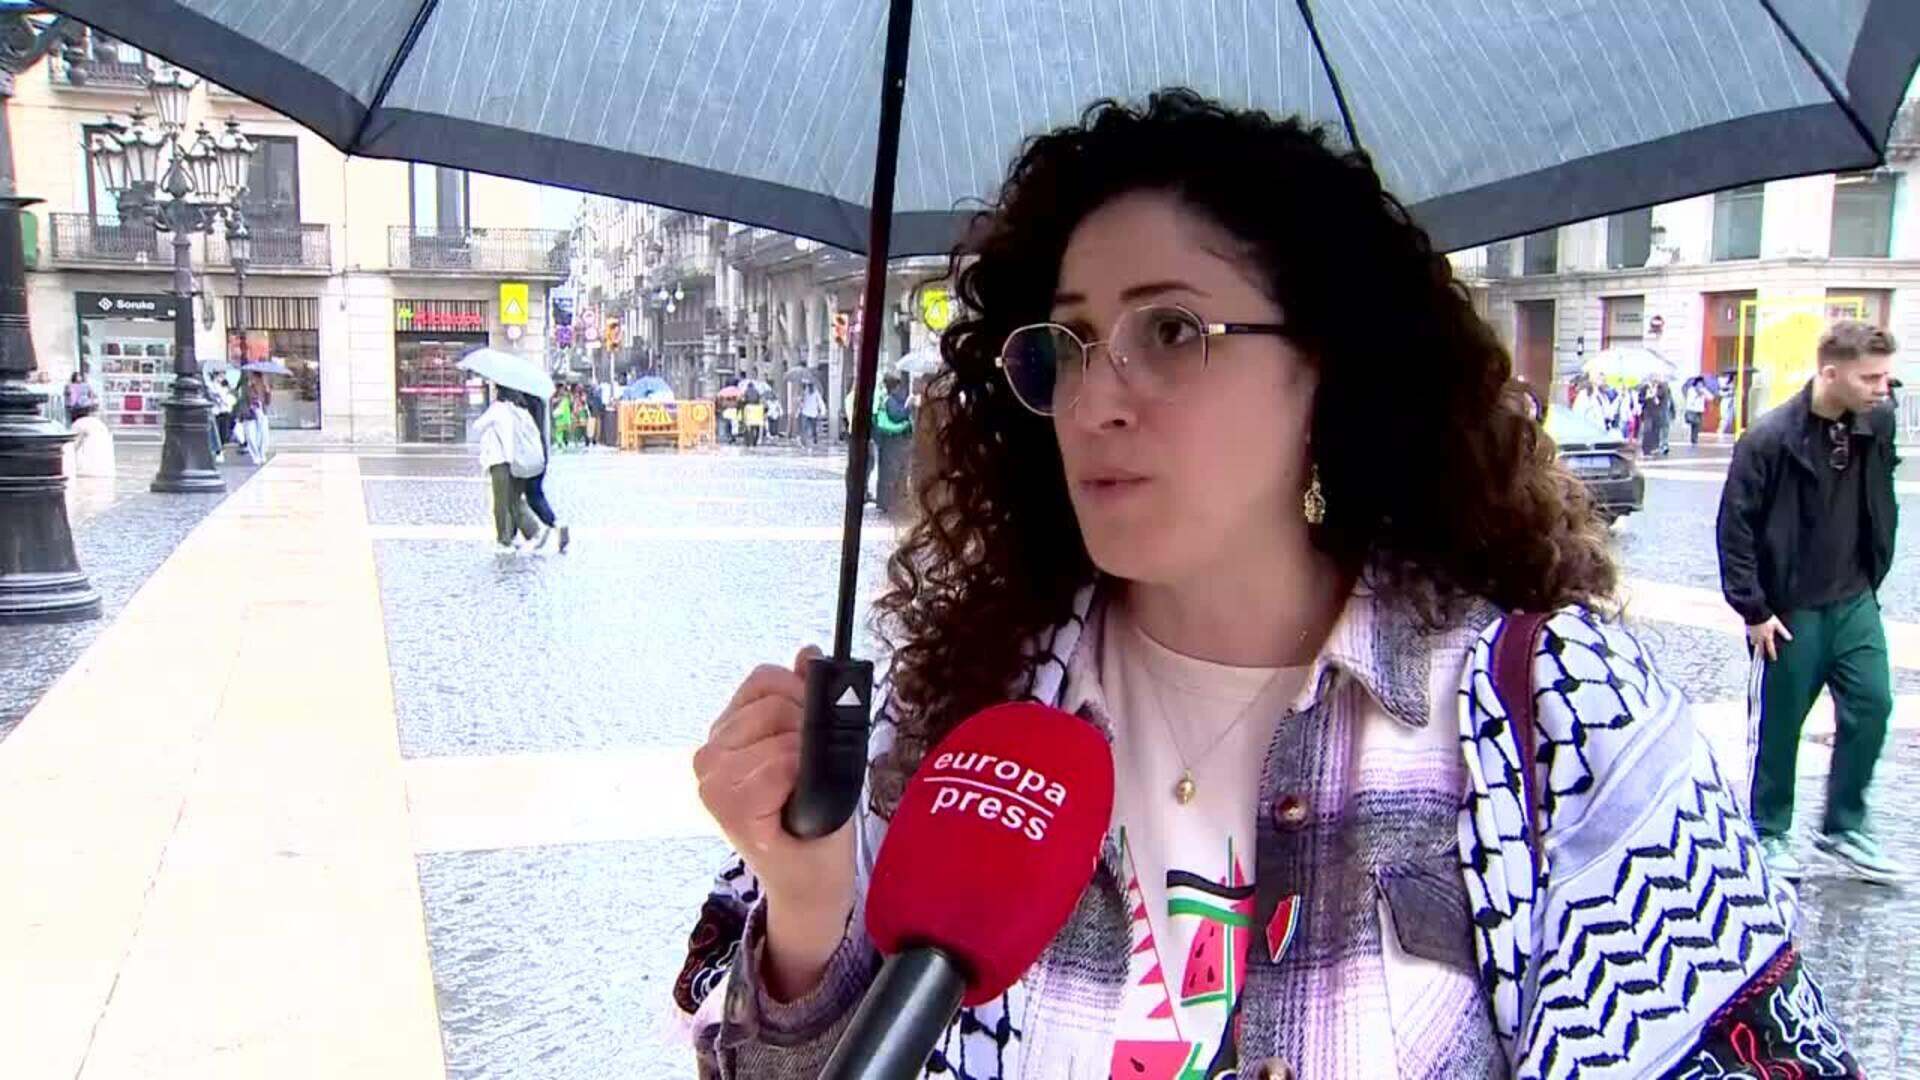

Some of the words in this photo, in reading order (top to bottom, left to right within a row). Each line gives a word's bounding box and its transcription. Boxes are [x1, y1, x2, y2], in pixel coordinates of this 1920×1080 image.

[116, 299, 155, 310] Soruka
[934, 752, 1067, 807] europa
[930, 786, 1048, 841] press
